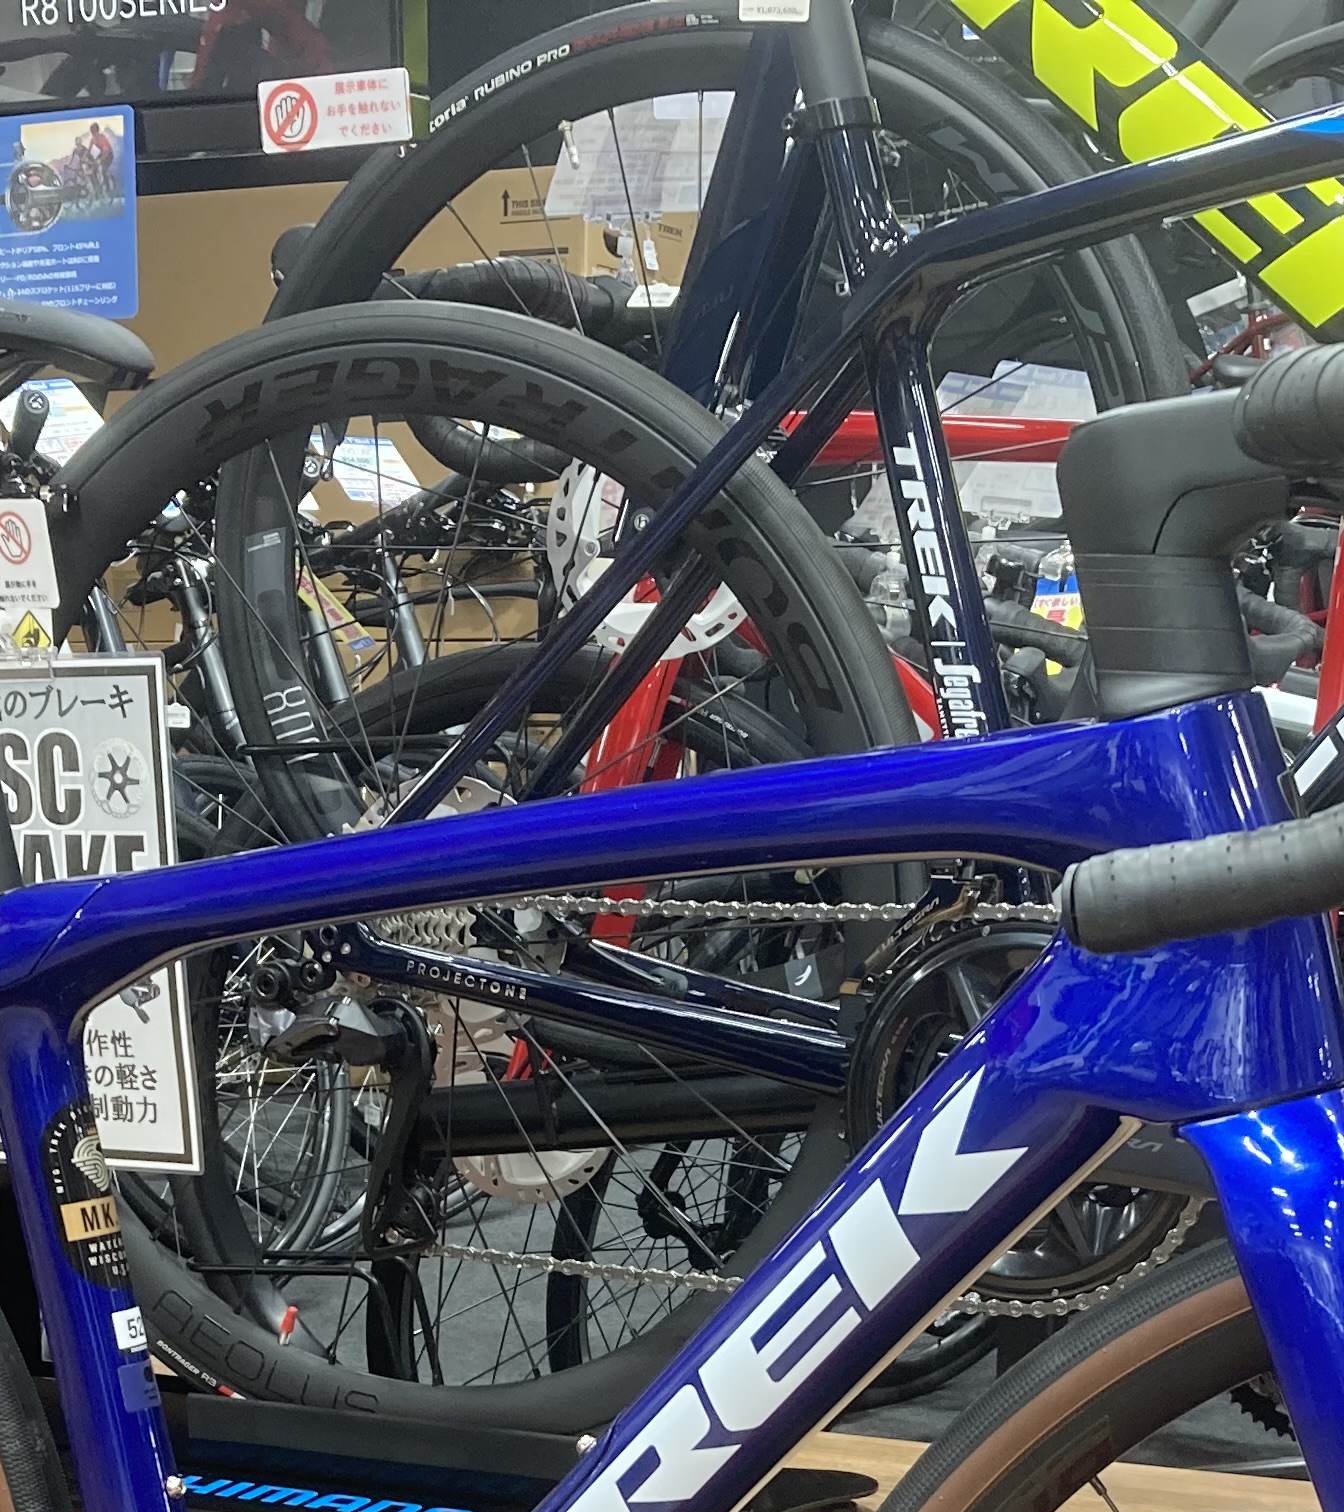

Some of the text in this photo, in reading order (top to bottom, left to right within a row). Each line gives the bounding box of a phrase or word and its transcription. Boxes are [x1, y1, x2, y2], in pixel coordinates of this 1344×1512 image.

[474, 59, 532, 101] RUBINO
[536, 44, 570, 68] PRO
[892, 432, 958, 629] TREK
[157, 1340, 217, 1388] BONTRAGER R3
